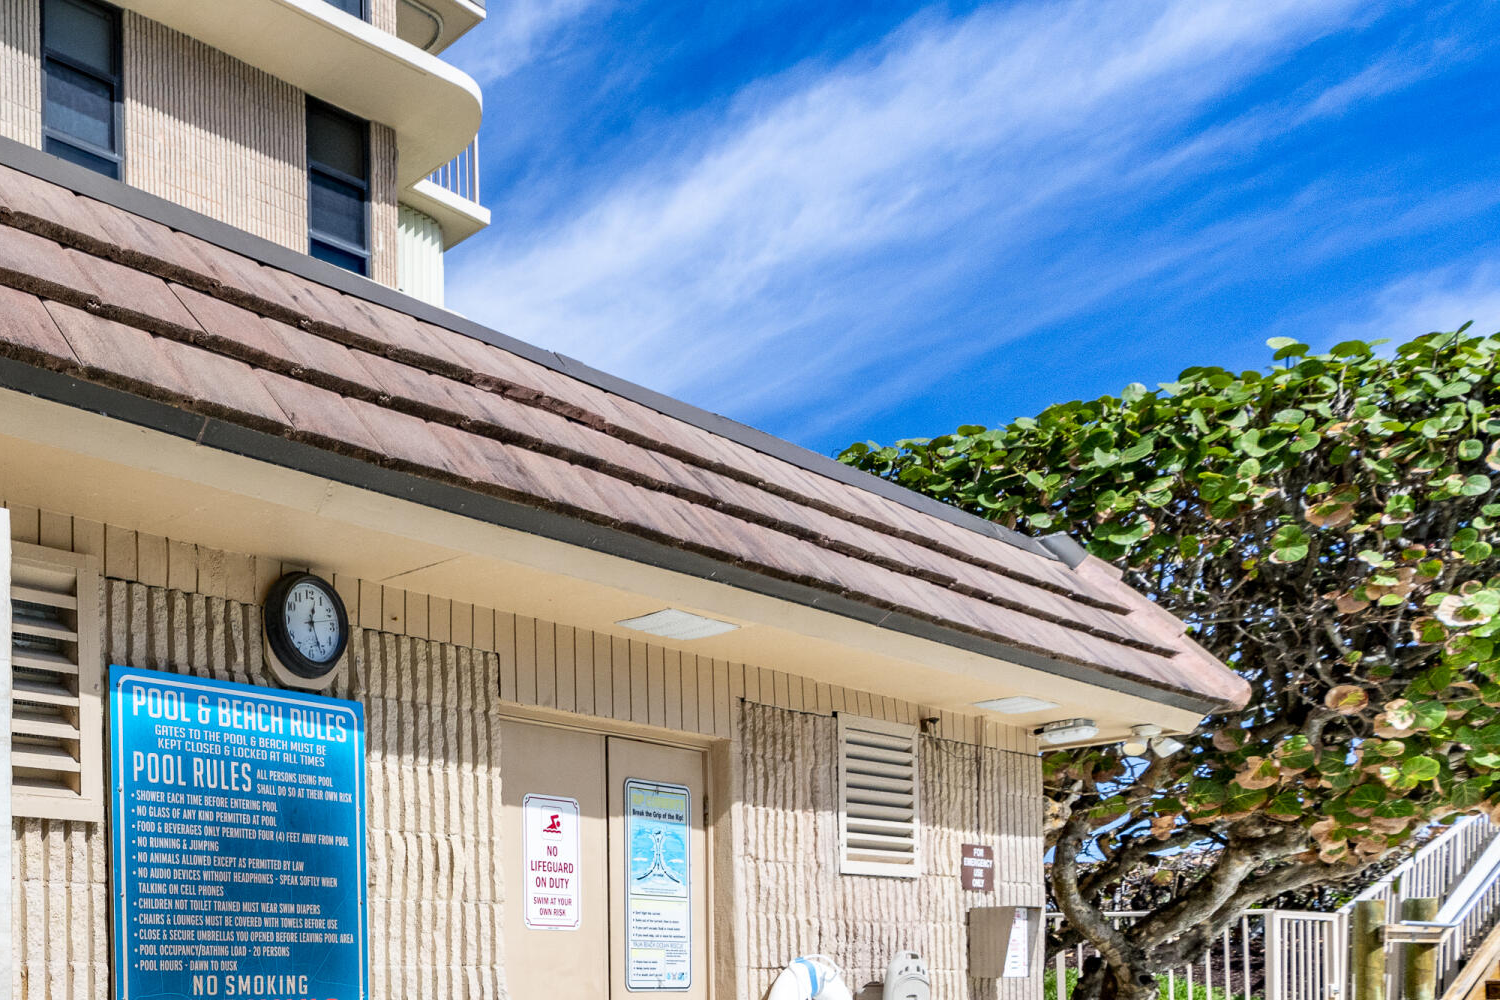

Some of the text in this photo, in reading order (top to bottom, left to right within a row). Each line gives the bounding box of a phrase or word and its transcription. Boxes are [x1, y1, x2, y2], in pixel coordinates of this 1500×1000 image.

[294, 592, 302, 602] 11
[305, 590, 314, 600] 12
[319, 597, 322, 606] 1
[288, 601, 296, 611] 10
[326, 608, 332, 618] 2
[330, 622, 335, 632] 3
[308, 649, 315, 658] 6
[132, 685, 346, 742] POOL & BEACH RULES
[154, 724, 325, 755] GATES TO THE POOL & BEACH MUST BE
[157, 737, 324, 767] KEPT CLOSED & LOCKED AT ALL TIMES
[133, 750, 251, 792] POOL RULES
[256, 769, 332, 787] ALL PERSONS USING POOL
[136, 789, 276, 812] SHOWER EACH TIME BEFORE ENTERING POOL
[136, 804, 276, 826] NO GLASS OF ANY KIND PERMITTED AT POOL
[653, 811, 661, 819] Grip
[136, 820, 348, 846] FOOD & BEVERAGES ONLY PERMITTED FOUR (4) FEET AWAY FROM POOL
[137, 836, 218, 851] NO RUNNING & JUMPING
[547, 846, 558, 856] NO
[973, 848, 984, 857] FOR
[137, 851, 304, 871] NO ANIMALS ALLOWED EXCEPT AS PERMITTED BY LAW
[531, 860, 573, 873] LIFEGUARD
[138, 866, 337, 887] NO AUDIO DEVICES WITHOUT HEADPHONES SPEAK SOFTLY WHEN
[536, 877, 569, 888] ON DUTY
[138, 882, 223, 896] TALKING ON CELL PHONES
[138, 897, 320, 914] CHILDREN NOT TOILET TRAINED MUST WEAR SWIM DIAPERS
[534, 897, 549, 905] SWIM
[558, 898, 572, 906] YOUR
[138, 913, 337, 929] CHAIRS & LOUNGES MUST BE COVERED WITH TOWELS BEFORE USE
[139, 928, 353, 943] CLOSE & SECURE UMBRELLAS YOU OPENED BEFORE LEAVING POOL AREA
[139, 944, 289, 956] POOL OCCUPANCY/BATHING LOAD 20 PERSONS
[139, 959, 237, 970] POOL HOURS DAWN TO DUSK
[193, 975, 307, 995] NO SMOKING
